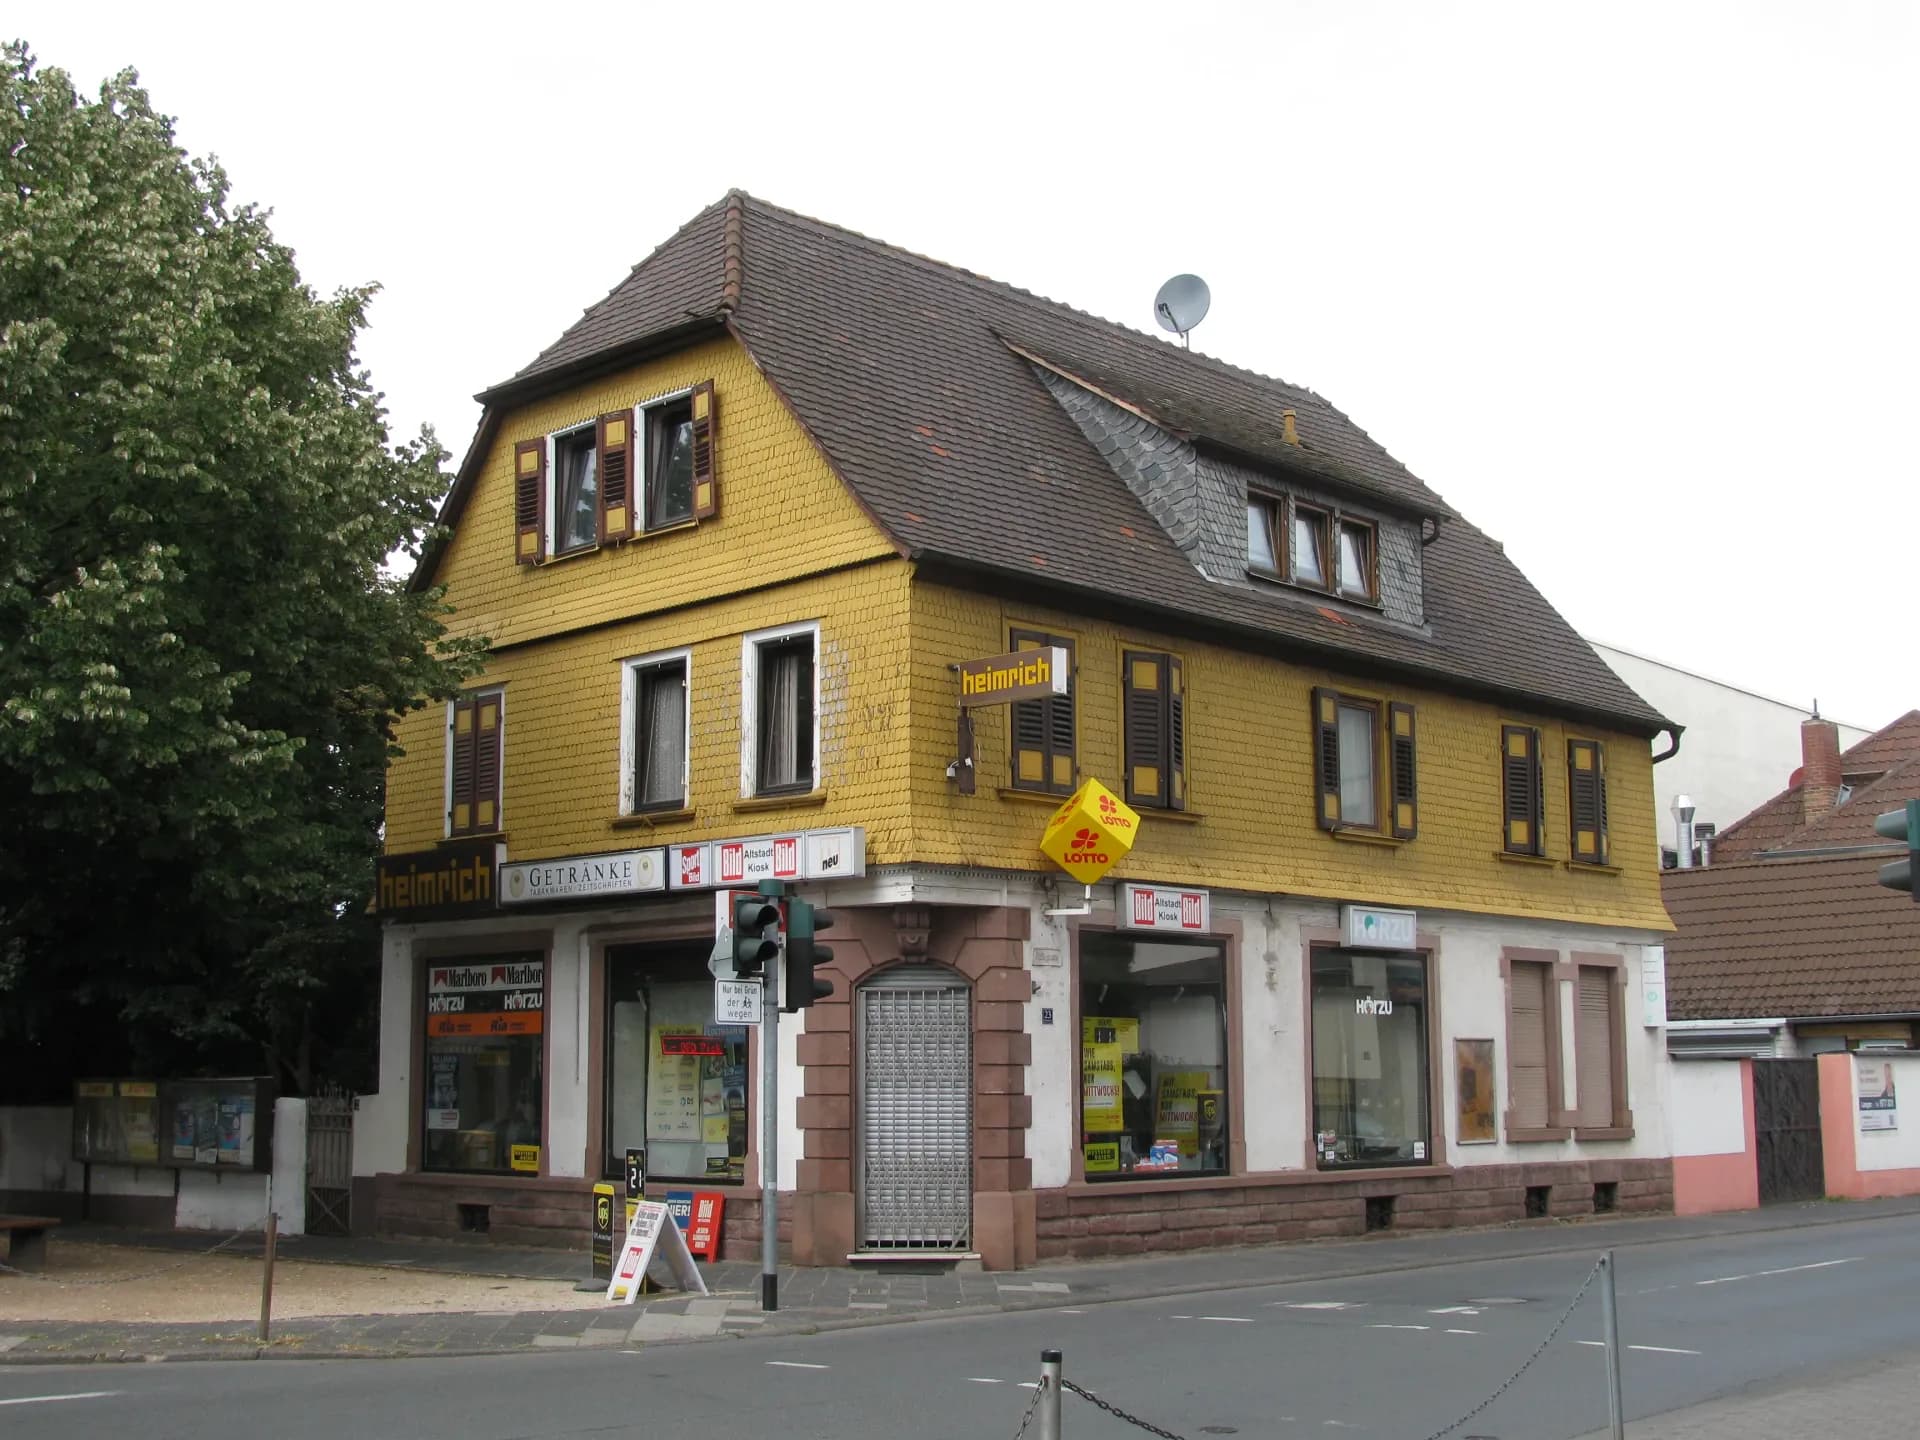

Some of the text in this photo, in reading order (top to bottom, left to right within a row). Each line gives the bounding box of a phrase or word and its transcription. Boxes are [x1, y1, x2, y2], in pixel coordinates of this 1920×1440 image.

[963, 657, 1049, 695] heimrich
[1099, 815, 1132, 829] LOTTO
[682, 849, 700, 874] Sport
[722, 846, 742, 877] Bild
[743, 848, 774, 859] Altstadt
[775, 841, 796, 873] Bild
[1063, 853, 1109, 864] LOTTO
[747, 863, 770, 873] Kiosk
[821, 853, 839, 872] neu
[529, 860, 632, 887] GETRÄNKE
[688, 871, 700, 883] Bild
[379, 855, 491, 909] heimrich
[1135, 891, 1154, 922] Bild
[1154, 897, 1181, 908] Altstadt
[1182, 895, 1201, 925] Bild
[1158, 911, 1178, 922] Kiosk
[447, 967, 487, 988] Marlboro
[722, 983, 758, 995] Nur bei Grün
[726, 997, 740, 1008] der
[727, 1009, 753, 1020] wegen
[630, 1167, 642, 1189] 21
[670, 1204, 691, 1217] IER!
